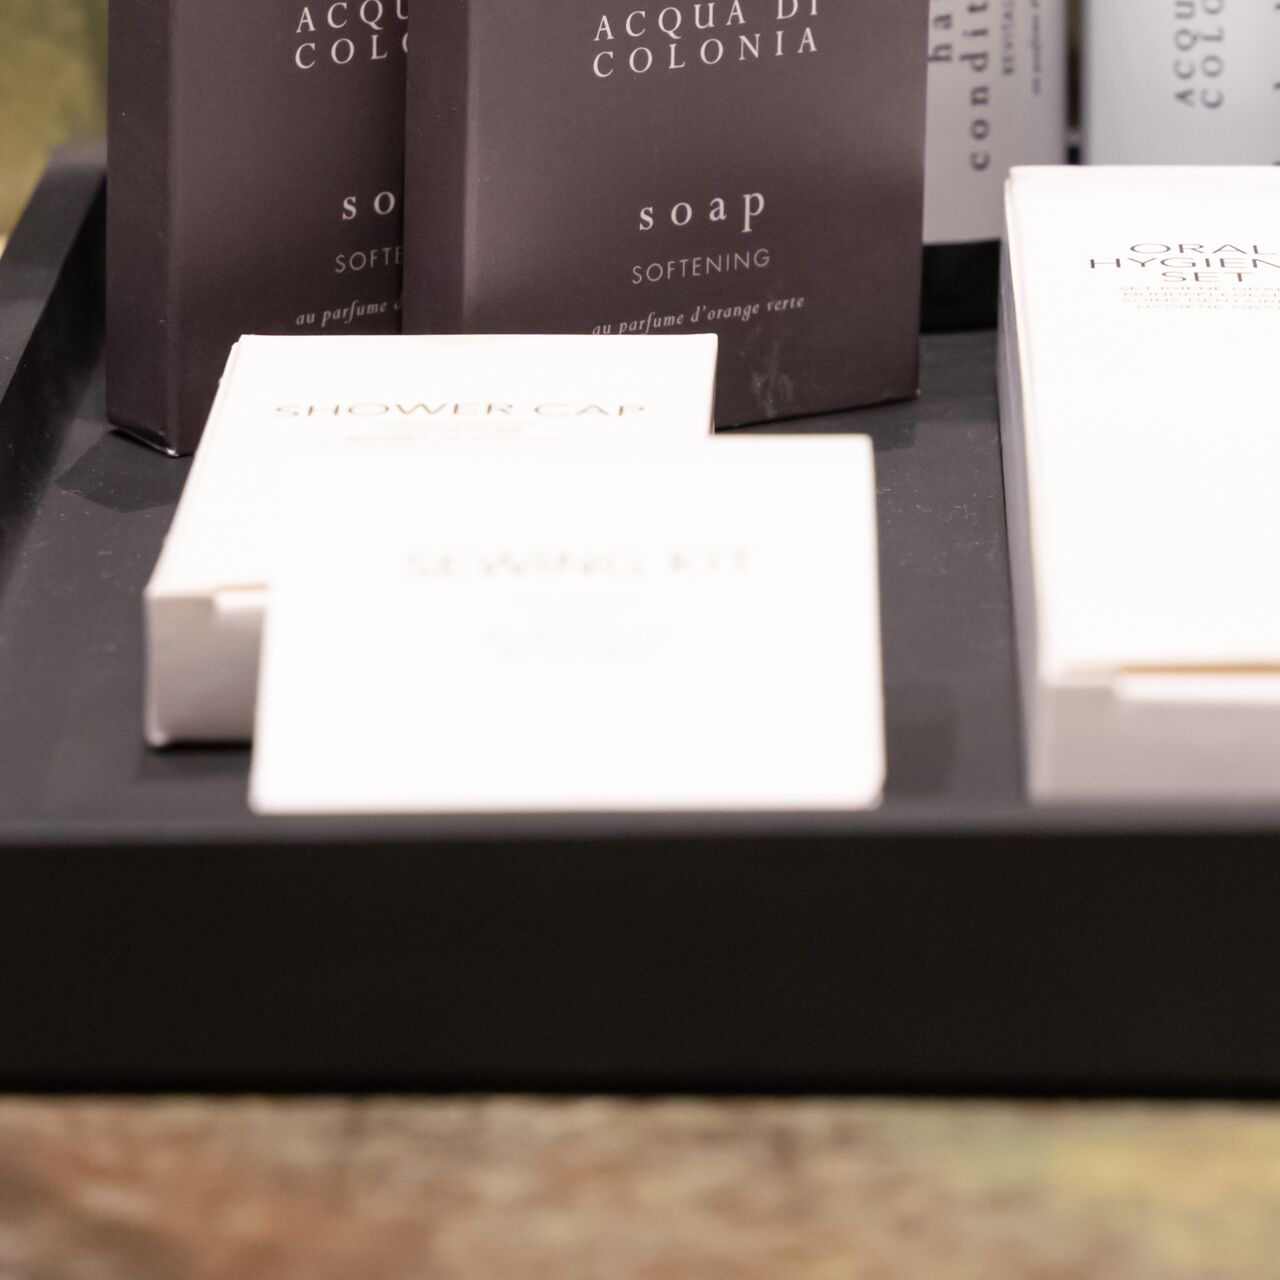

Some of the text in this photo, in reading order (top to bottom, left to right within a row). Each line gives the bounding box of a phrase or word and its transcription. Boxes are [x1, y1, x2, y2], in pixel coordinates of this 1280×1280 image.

[593, 0, 747, 41] ACQUA
[294, 32, 408, 69] COL
[592, 27, 818, 77] COLONIA
[638, 192, 766, 233] soap
[632, 248, 770, 284] SOFTENING
[1130, 243, 1277, 255] ORAL
[1161, 271, 1255, 282] SET
[296, 313, 316, 325] au
[321, 299, 388, 328] parfume
[592, 296, 805, 335] au parfume d'orange verte
[275, 402, 645, 417] SHOWER CAP
